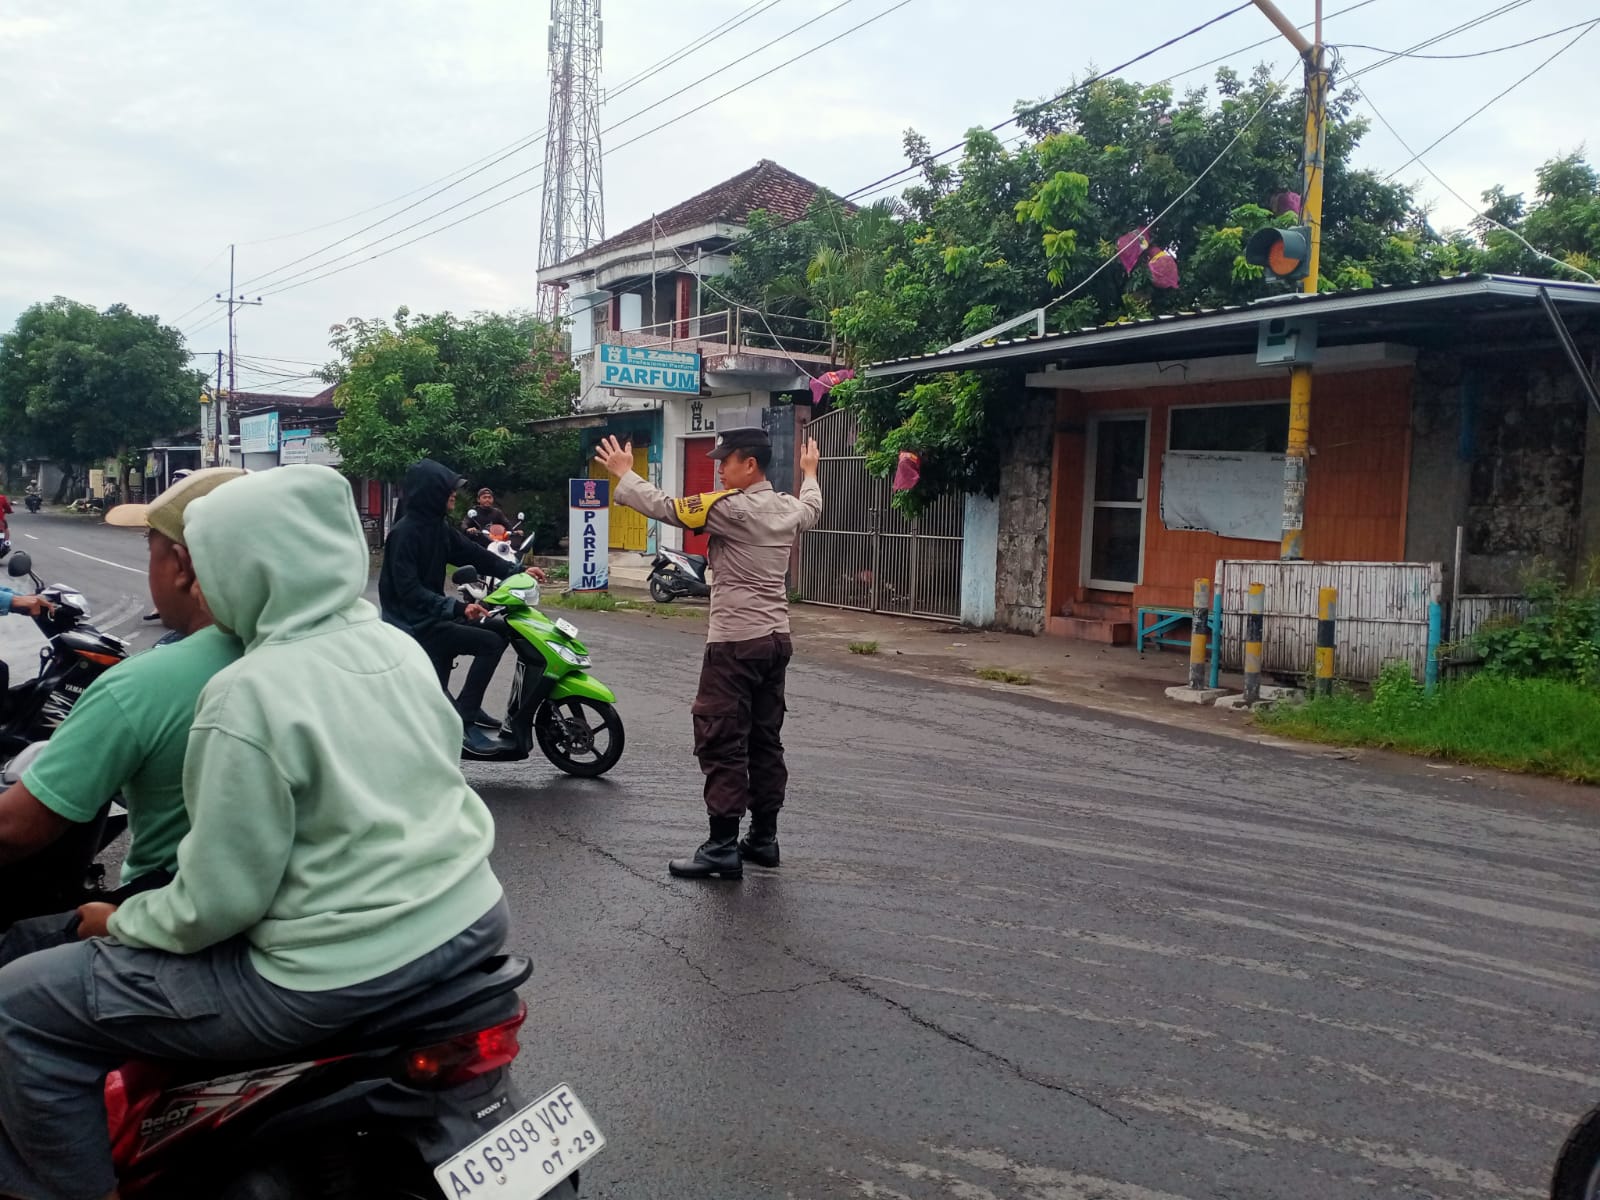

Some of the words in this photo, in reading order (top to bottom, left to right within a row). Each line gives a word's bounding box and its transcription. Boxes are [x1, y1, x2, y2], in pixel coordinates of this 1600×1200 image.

[606, 365, 695, 389] PARFUM
[582, 511, 597, 588] PARFUM
[449, 1159, 485, 1200] AG
[482, 1119, 541, 1174] 6998
[536, 1092, 575, 1134] VCF
